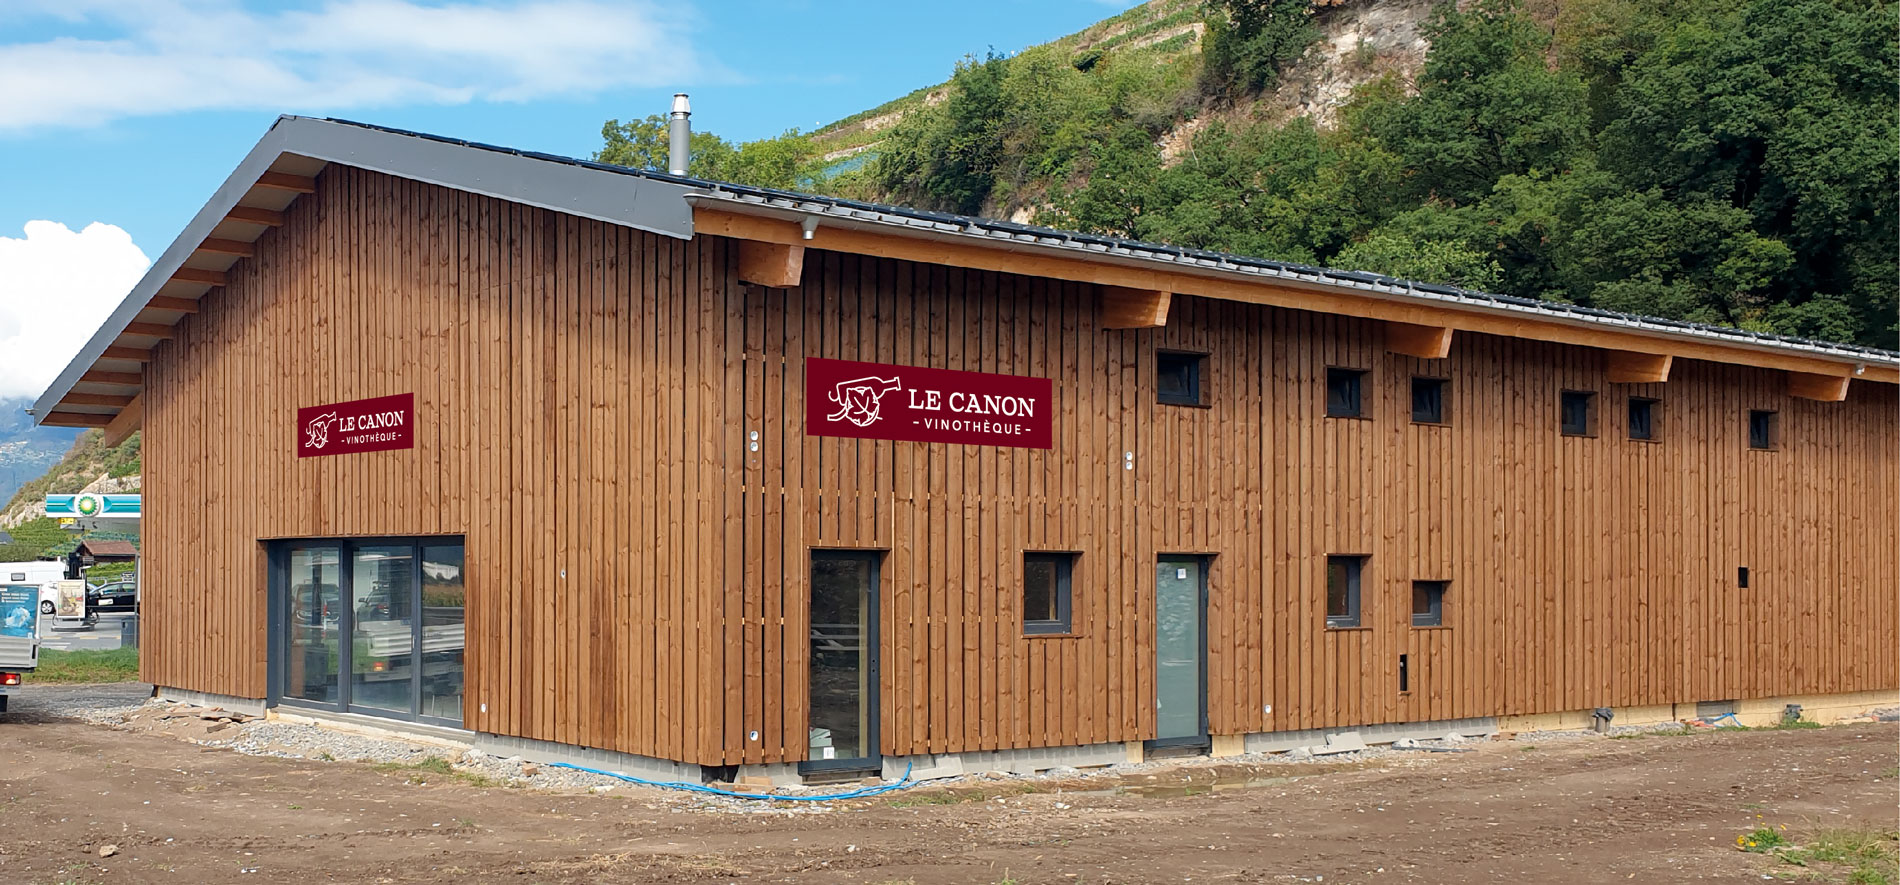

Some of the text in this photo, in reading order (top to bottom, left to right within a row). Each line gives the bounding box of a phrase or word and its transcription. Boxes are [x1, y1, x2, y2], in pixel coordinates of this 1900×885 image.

[908, 388, 1036, 418] LE CANON
[339, 410, 404, 432] LE CANON
